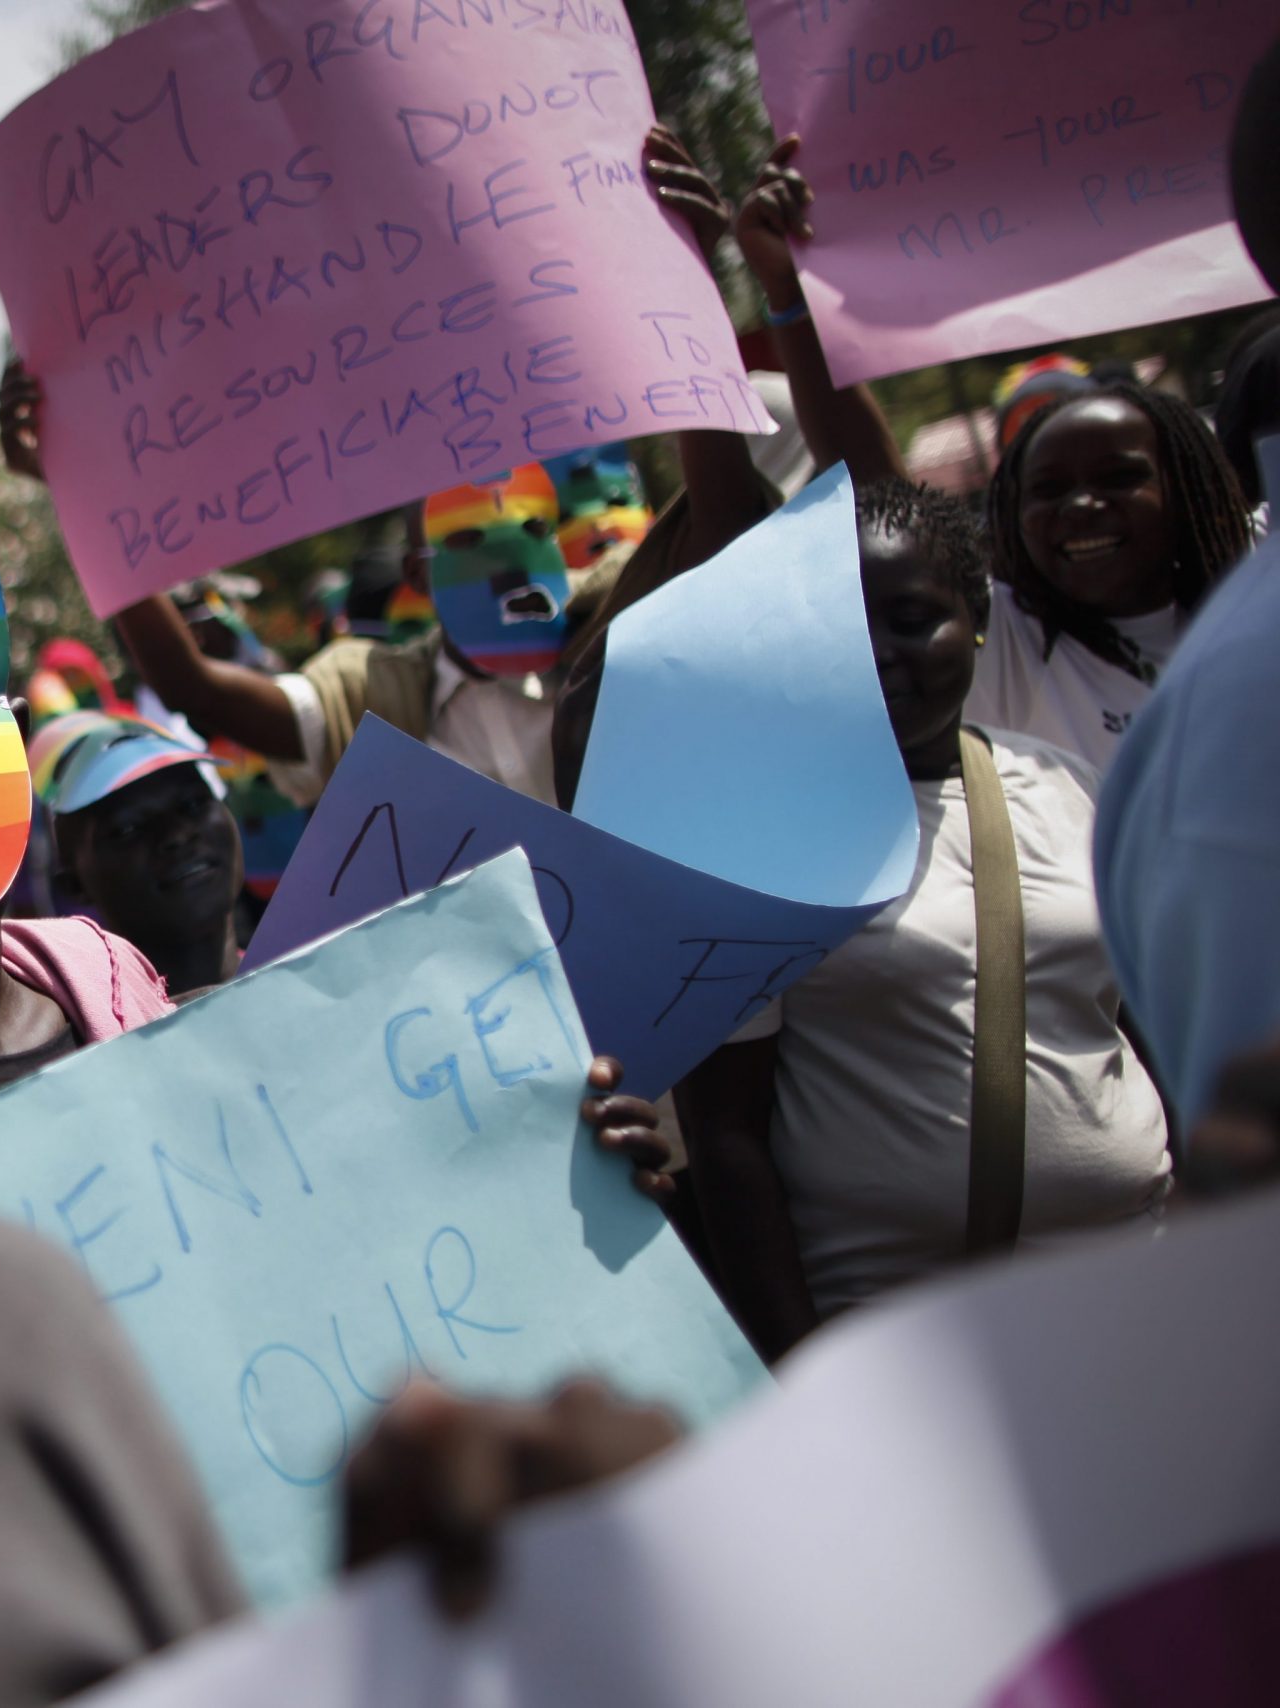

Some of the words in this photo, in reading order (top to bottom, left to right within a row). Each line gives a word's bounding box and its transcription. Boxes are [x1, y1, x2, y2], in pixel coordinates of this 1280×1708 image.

[39, 69, 200, 224] GAY
[65, 145, 334, 342] LEADERS
[849, 146, 956, 193] WAS
[125, 260, 579, 476] RESOURCES
[639, 311, 712, 367] TO
[22, 1082, 313, 1301] ENI
[384, 945, 600, 1132] GET
[240, 1226, 523, 1487] OUR
